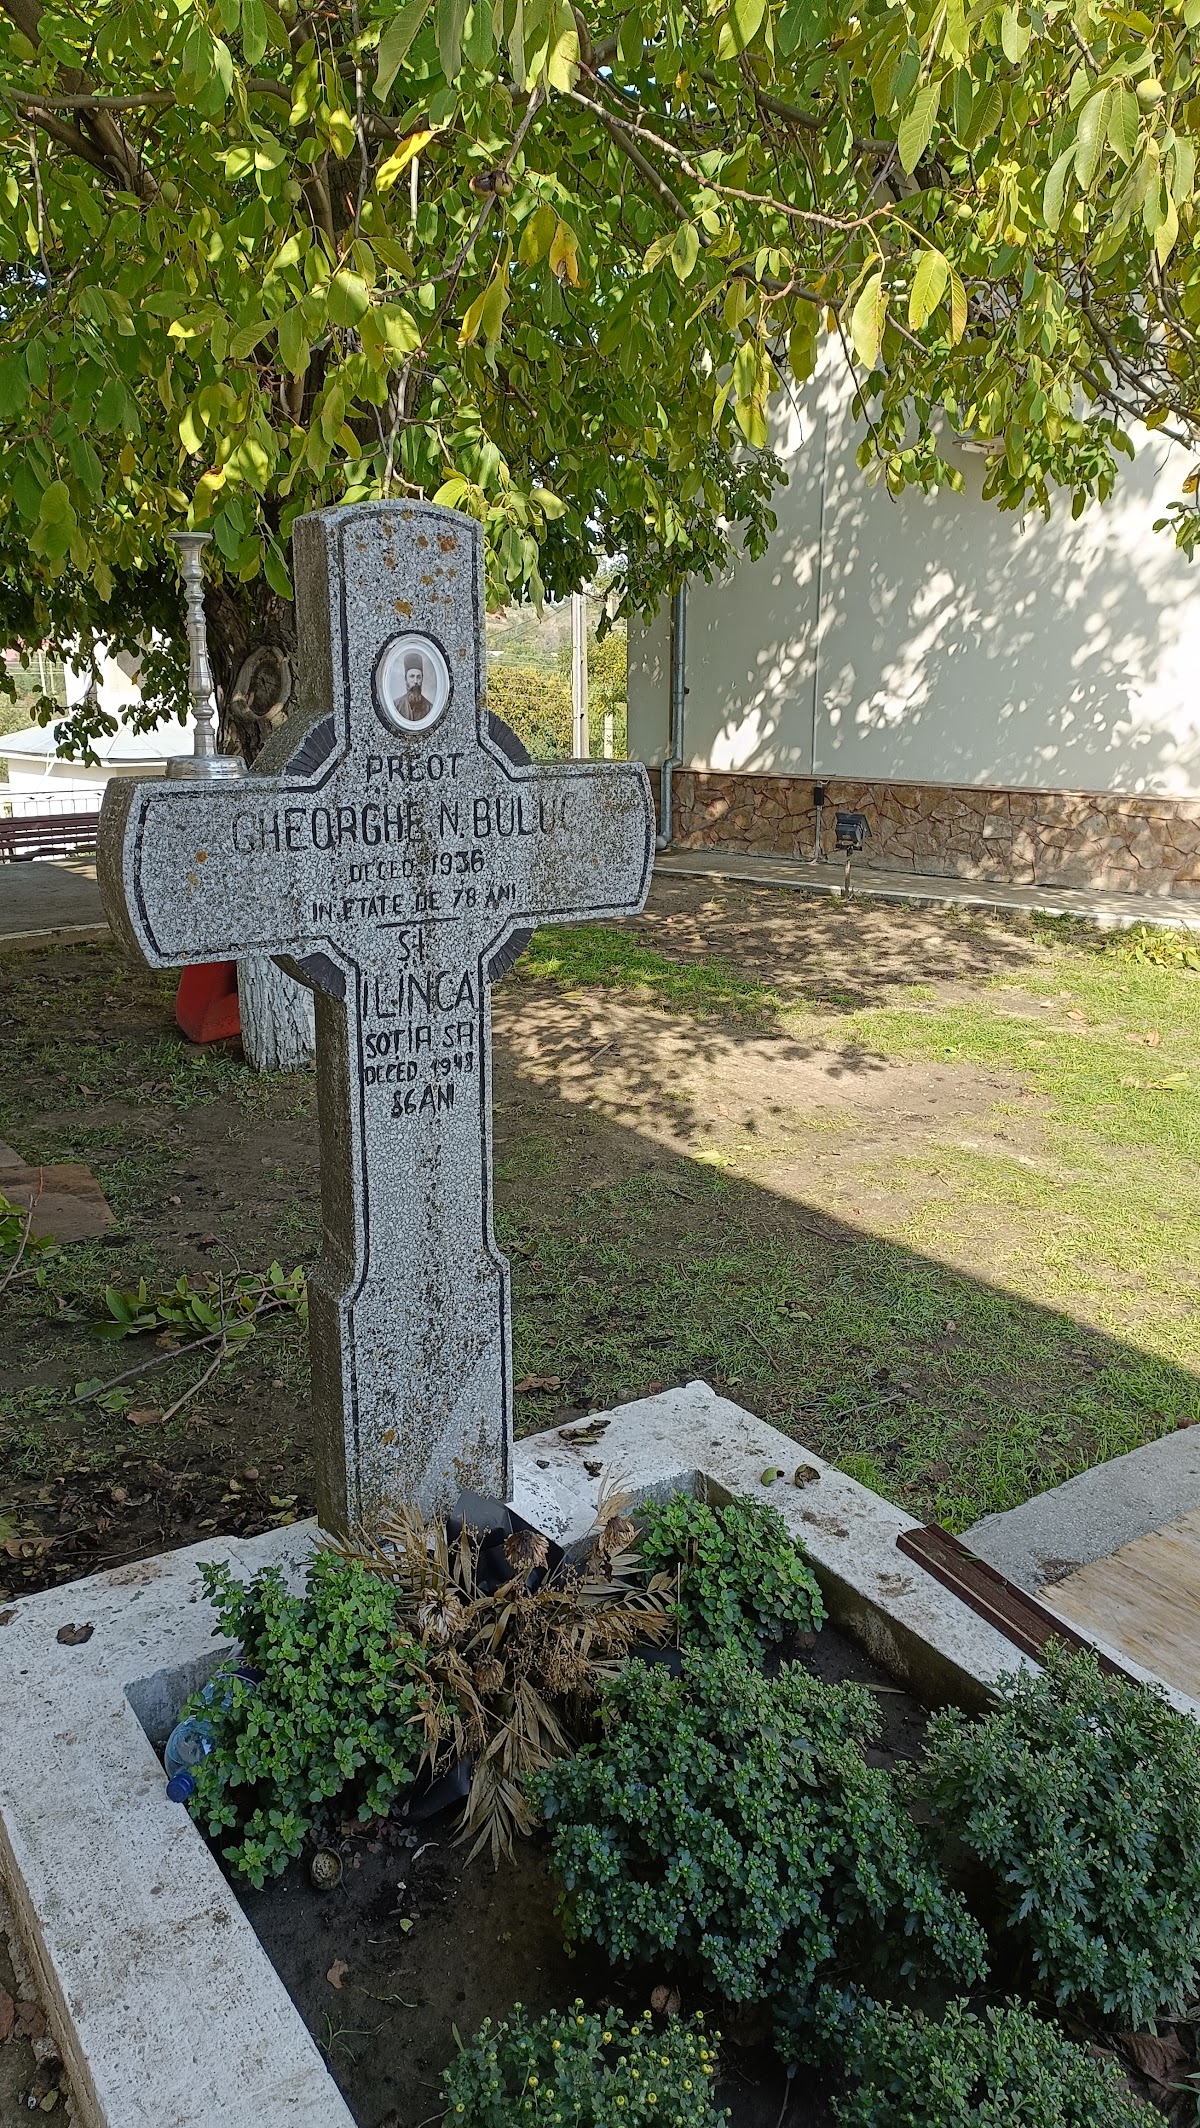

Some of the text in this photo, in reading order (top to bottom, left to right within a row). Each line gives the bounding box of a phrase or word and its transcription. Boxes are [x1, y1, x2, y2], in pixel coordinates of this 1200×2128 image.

[366, 753, 464, 782] PREOT
[232, 799, 422, 853] GHEORGHE
[431, 849, 484, 876] 1936
[363, 970, 475, 1020] ILINCA
[442, 1021, 473, 1048] SA
